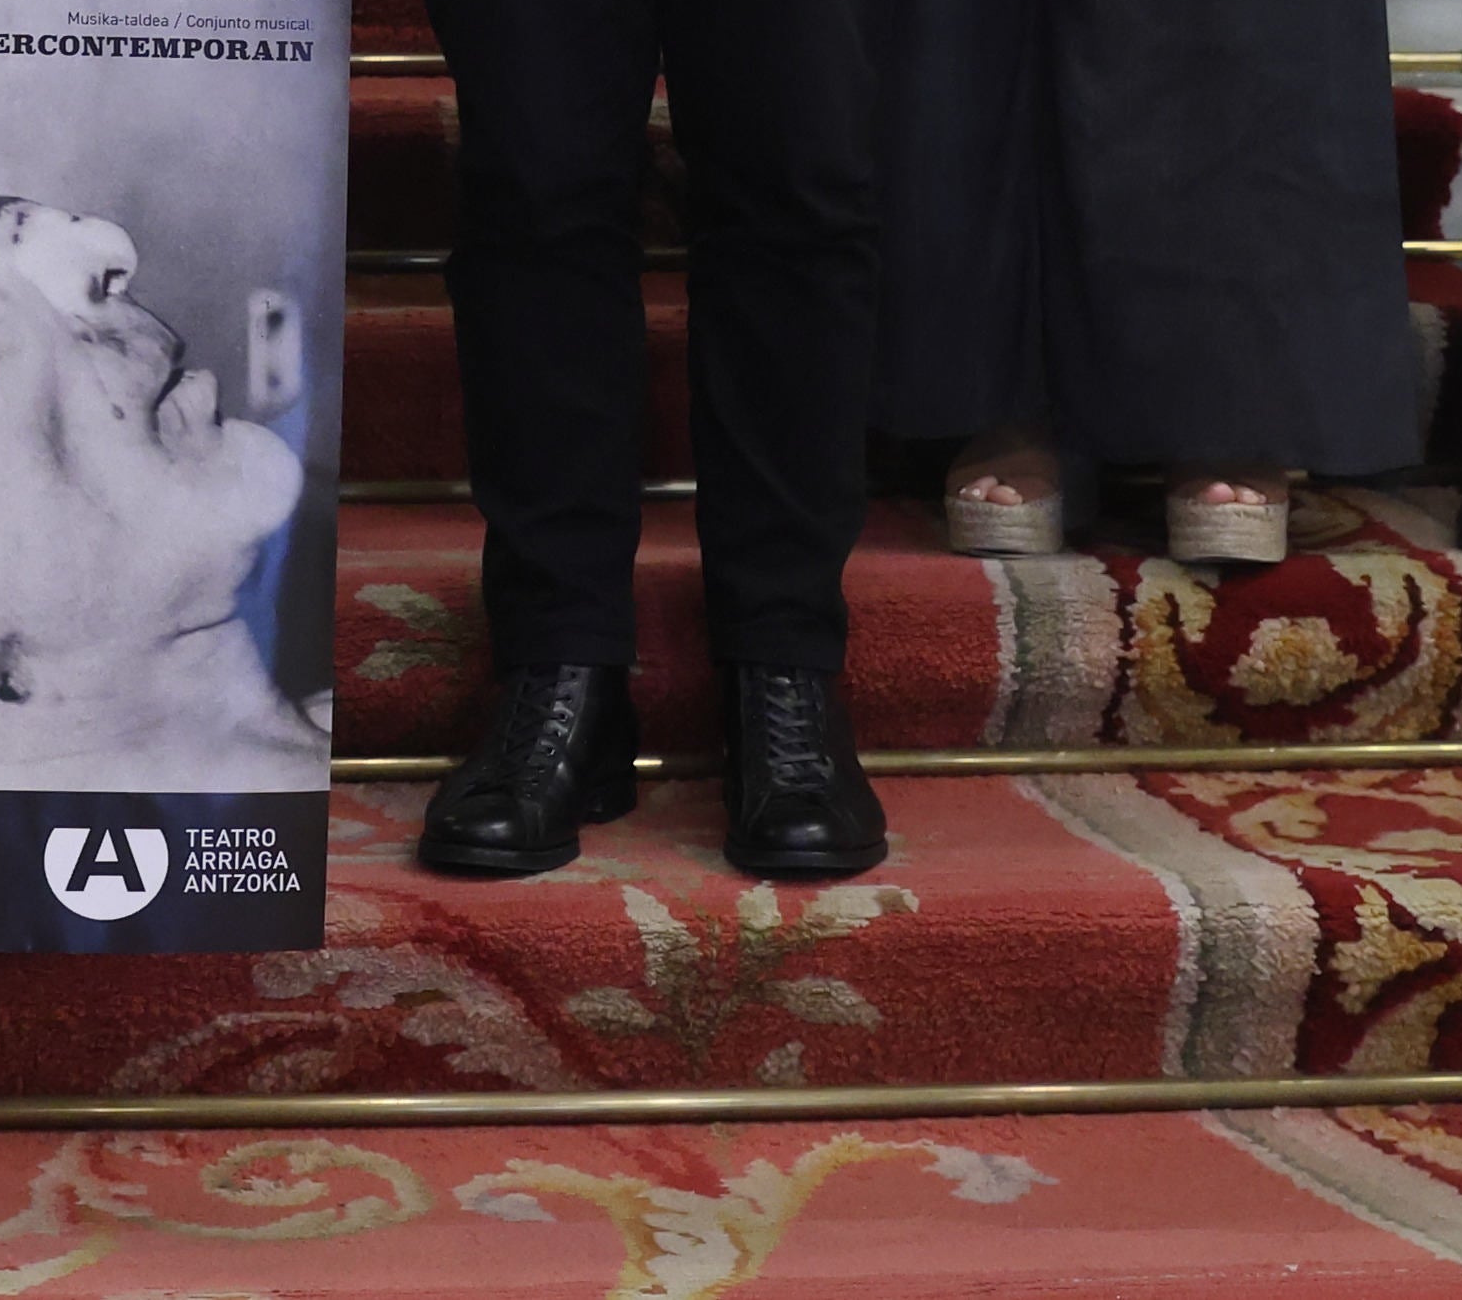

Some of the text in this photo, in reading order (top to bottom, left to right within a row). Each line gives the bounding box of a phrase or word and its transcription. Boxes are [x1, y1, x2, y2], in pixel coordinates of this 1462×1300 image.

[68, 12, 169, 28] Musika-taldea
[186, 14, 251, 31] Conjunto
[185, 828, 276, 849] TEATRO
[184, 850, 289, 870] ARRIAGA
[183, 872, 301, 893] ANTZOKIA
